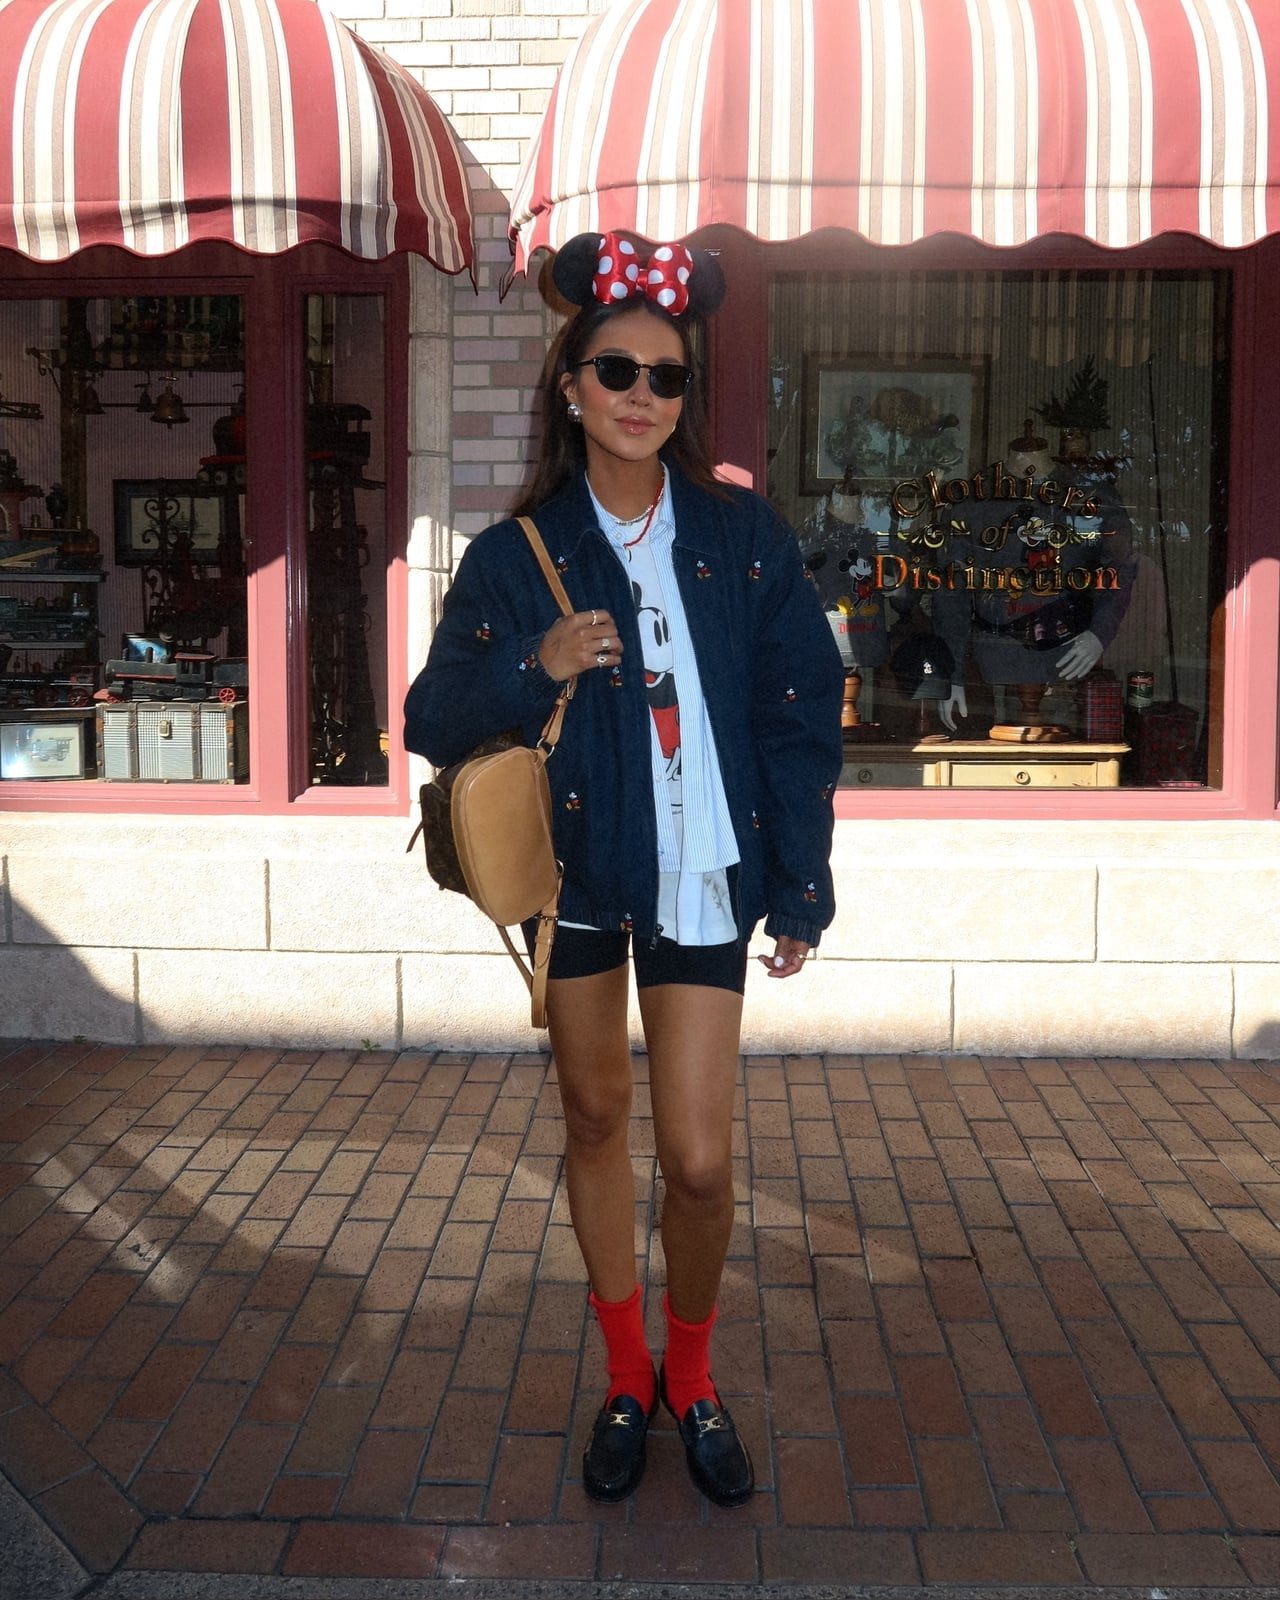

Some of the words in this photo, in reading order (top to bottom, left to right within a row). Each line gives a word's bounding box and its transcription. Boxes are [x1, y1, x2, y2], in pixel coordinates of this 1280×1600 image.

[893, 461, 1100, 518] Clothiers
[981, 513, 1018, 551] of
[872, 553, 1121, 590] Distinction
